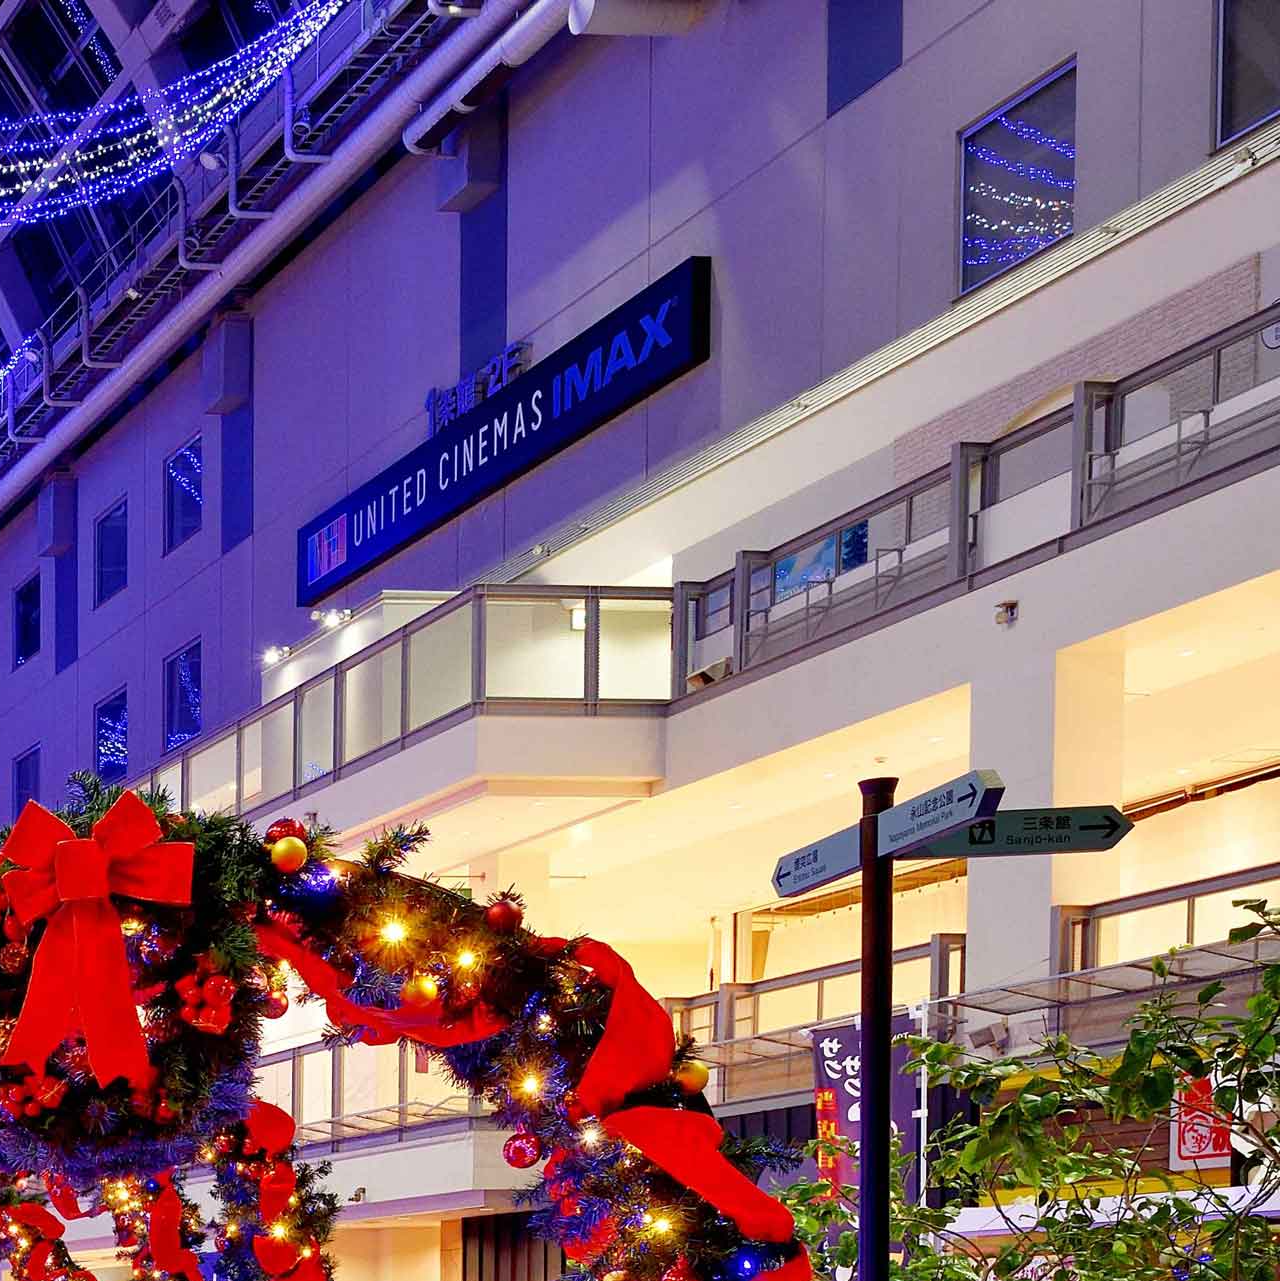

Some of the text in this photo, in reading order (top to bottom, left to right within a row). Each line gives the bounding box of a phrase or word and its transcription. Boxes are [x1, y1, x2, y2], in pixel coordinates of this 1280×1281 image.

[353, 298, 673, 547] UNITED CINEMAS IMAX
